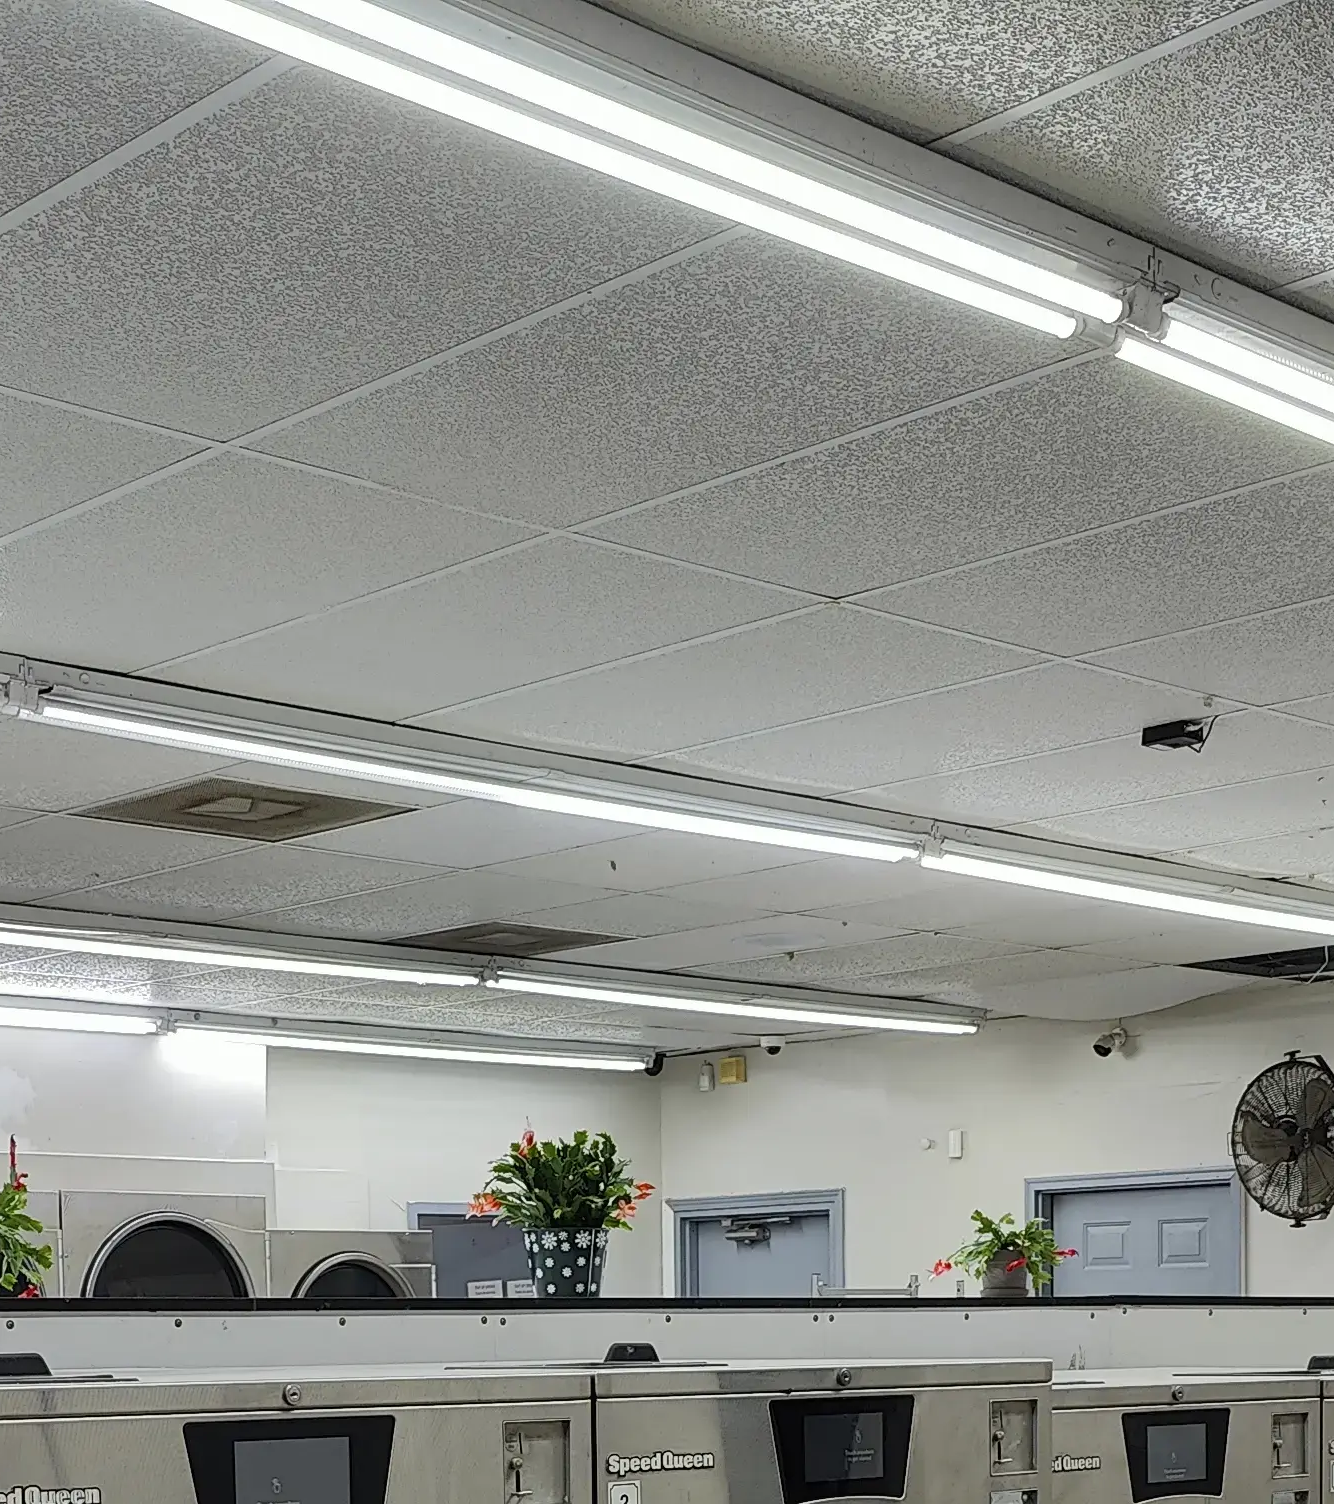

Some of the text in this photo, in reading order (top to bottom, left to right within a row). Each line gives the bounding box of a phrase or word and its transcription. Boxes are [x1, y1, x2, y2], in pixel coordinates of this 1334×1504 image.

[607, 1450, 714, 1477] Speed Queen
[1062, 1455, 1100, 1471] Queen
